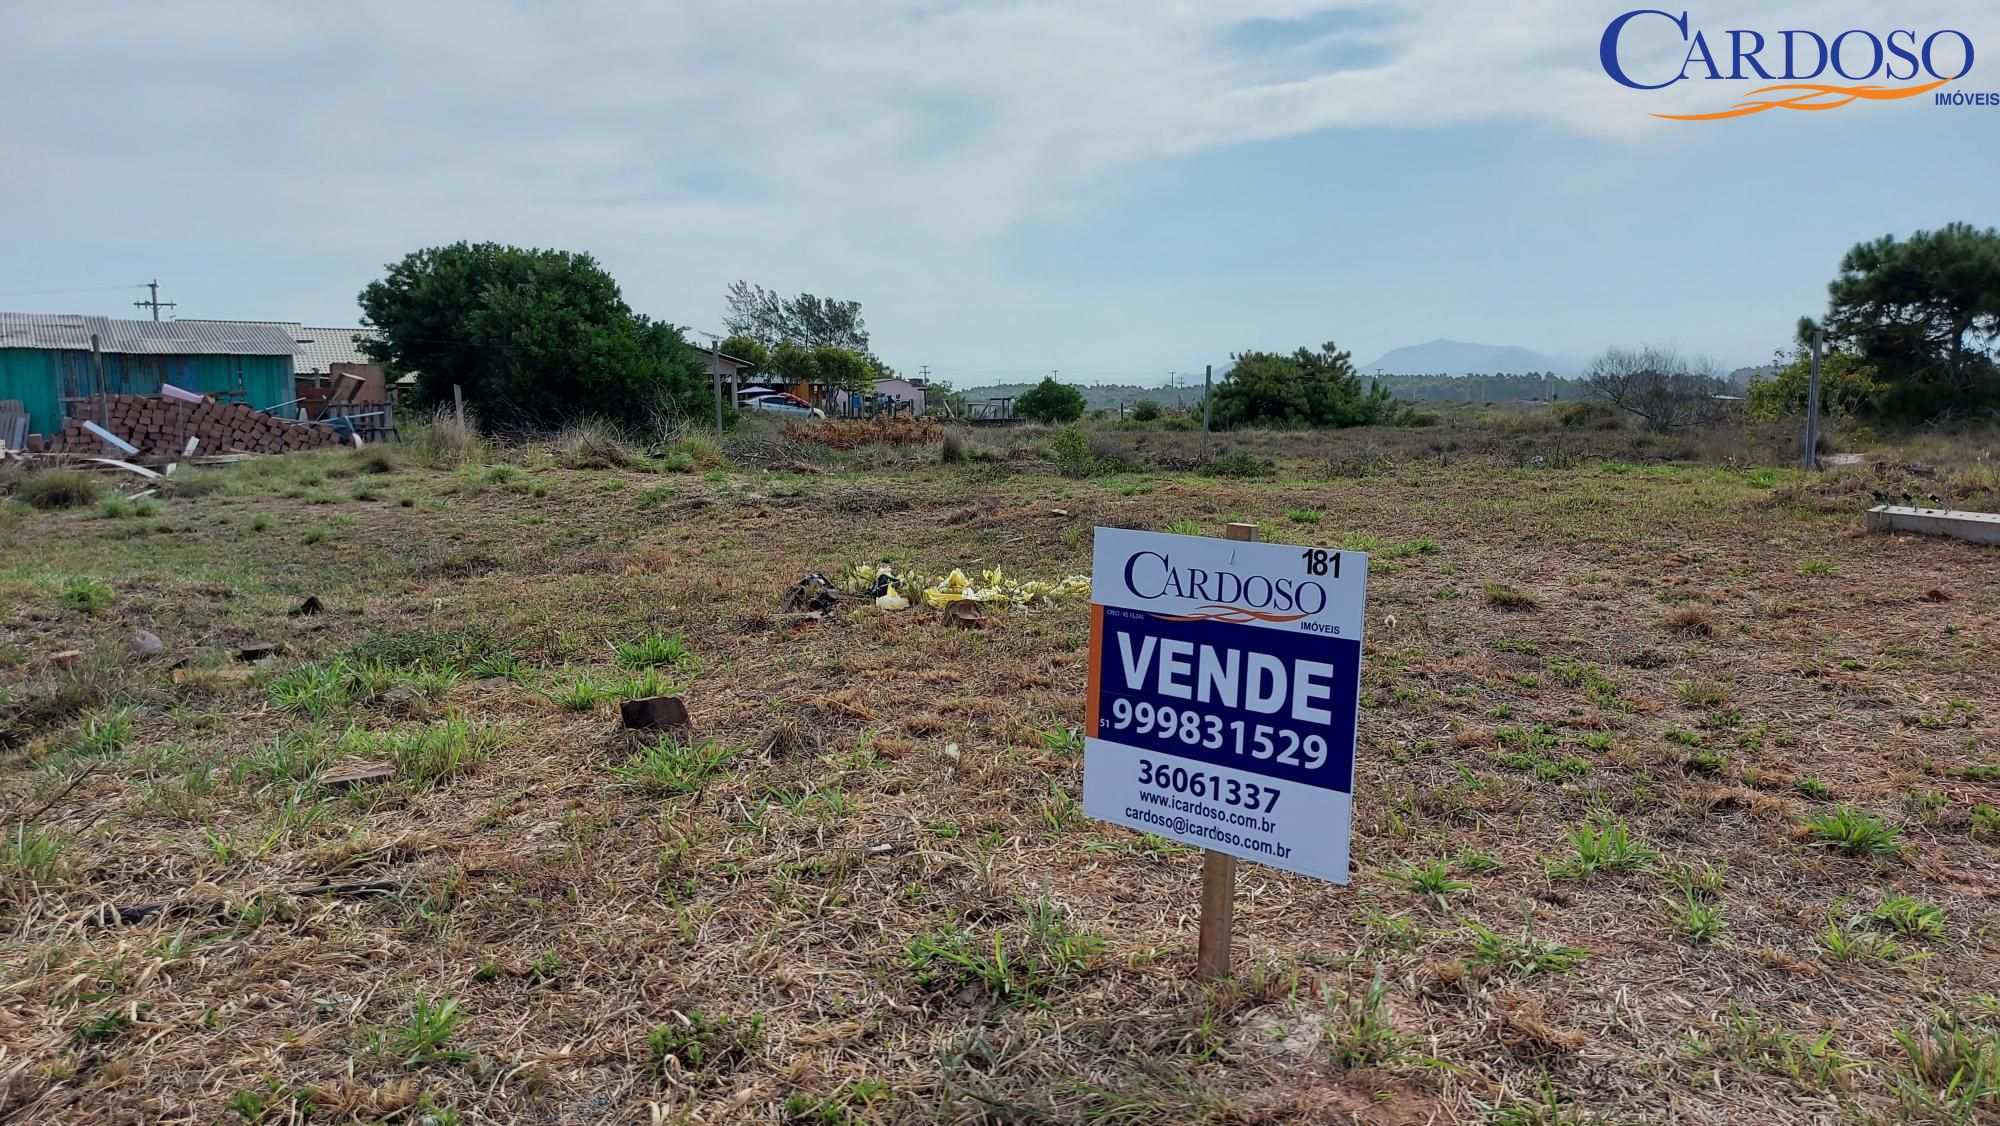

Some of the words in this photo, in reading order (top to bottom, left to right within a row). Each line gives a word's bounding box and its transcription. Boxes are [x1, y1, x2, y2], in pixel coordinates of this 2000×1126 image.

[1124, 551, 1327, 615] CARDOSO
[1302, 549, 1341, 579] 181
[1300, 620, 1341, 635] IMÓVEIS
[1116, 630, 1334, 726] VENDE
[1112, 698, 1328, 770] 999831529
[1138, 759, 1281, 814] 36061337
[1139, 790, 1276, 834] www.icardoso.com.br
[1125, 806, 1292, 859] cardoso@icardoso.com.br
